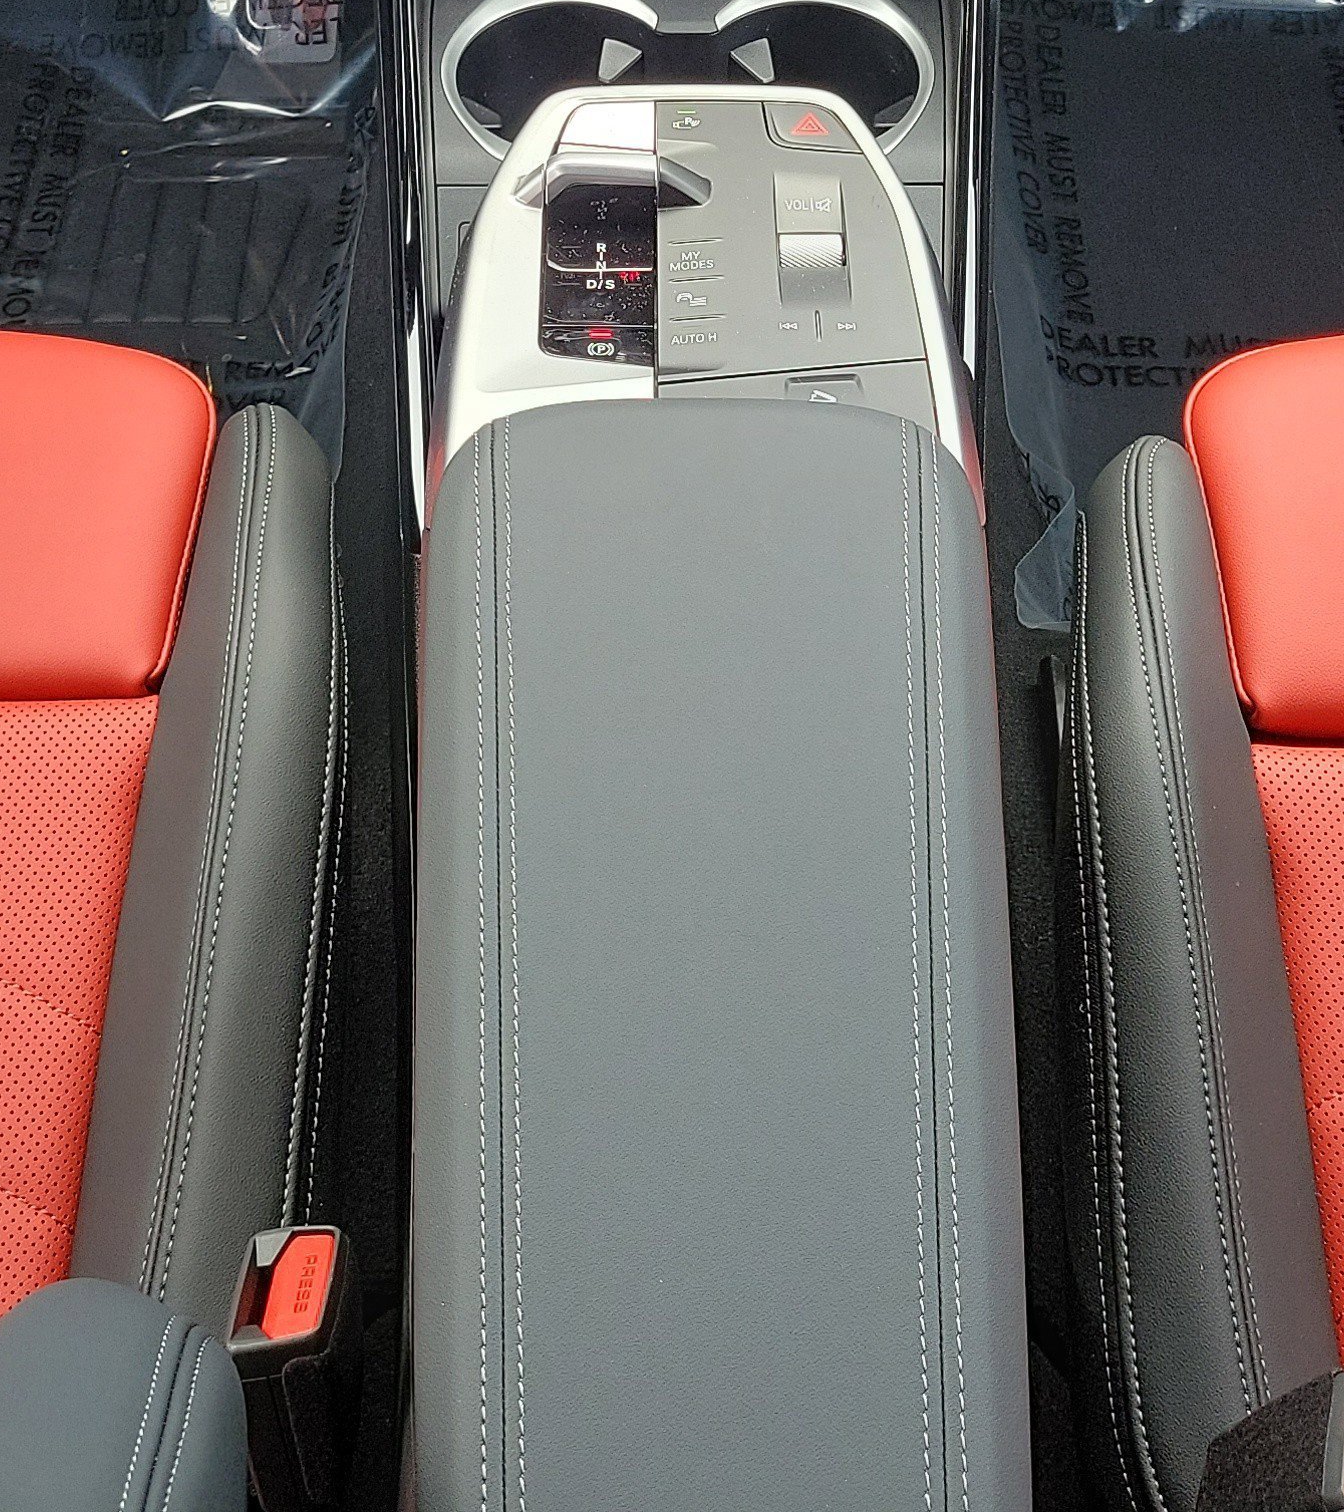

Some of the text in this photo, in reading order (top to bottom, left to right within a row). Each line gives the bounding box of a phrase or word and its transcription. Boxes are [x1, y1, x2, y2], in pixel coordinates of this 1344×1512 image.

[40, 31, 164, 59] REMOVE
[999, 19, 1050, 255] PROTECTIVE COVER
[1035, 23, 1096, 326] DEALER MUST REMOVE
[26, 172, 68, 238] MUST
[785, 199, 809, 211] VOL
[596, 242, 607, 253] R
[681, 251, 701, 261] MY
[669, 259, 715, 272] MODES
[586, 279, 616, 290] D/S
[671, 332, 717, 346] AUTO H
[293, 1253, 319, 1315] PRESS
